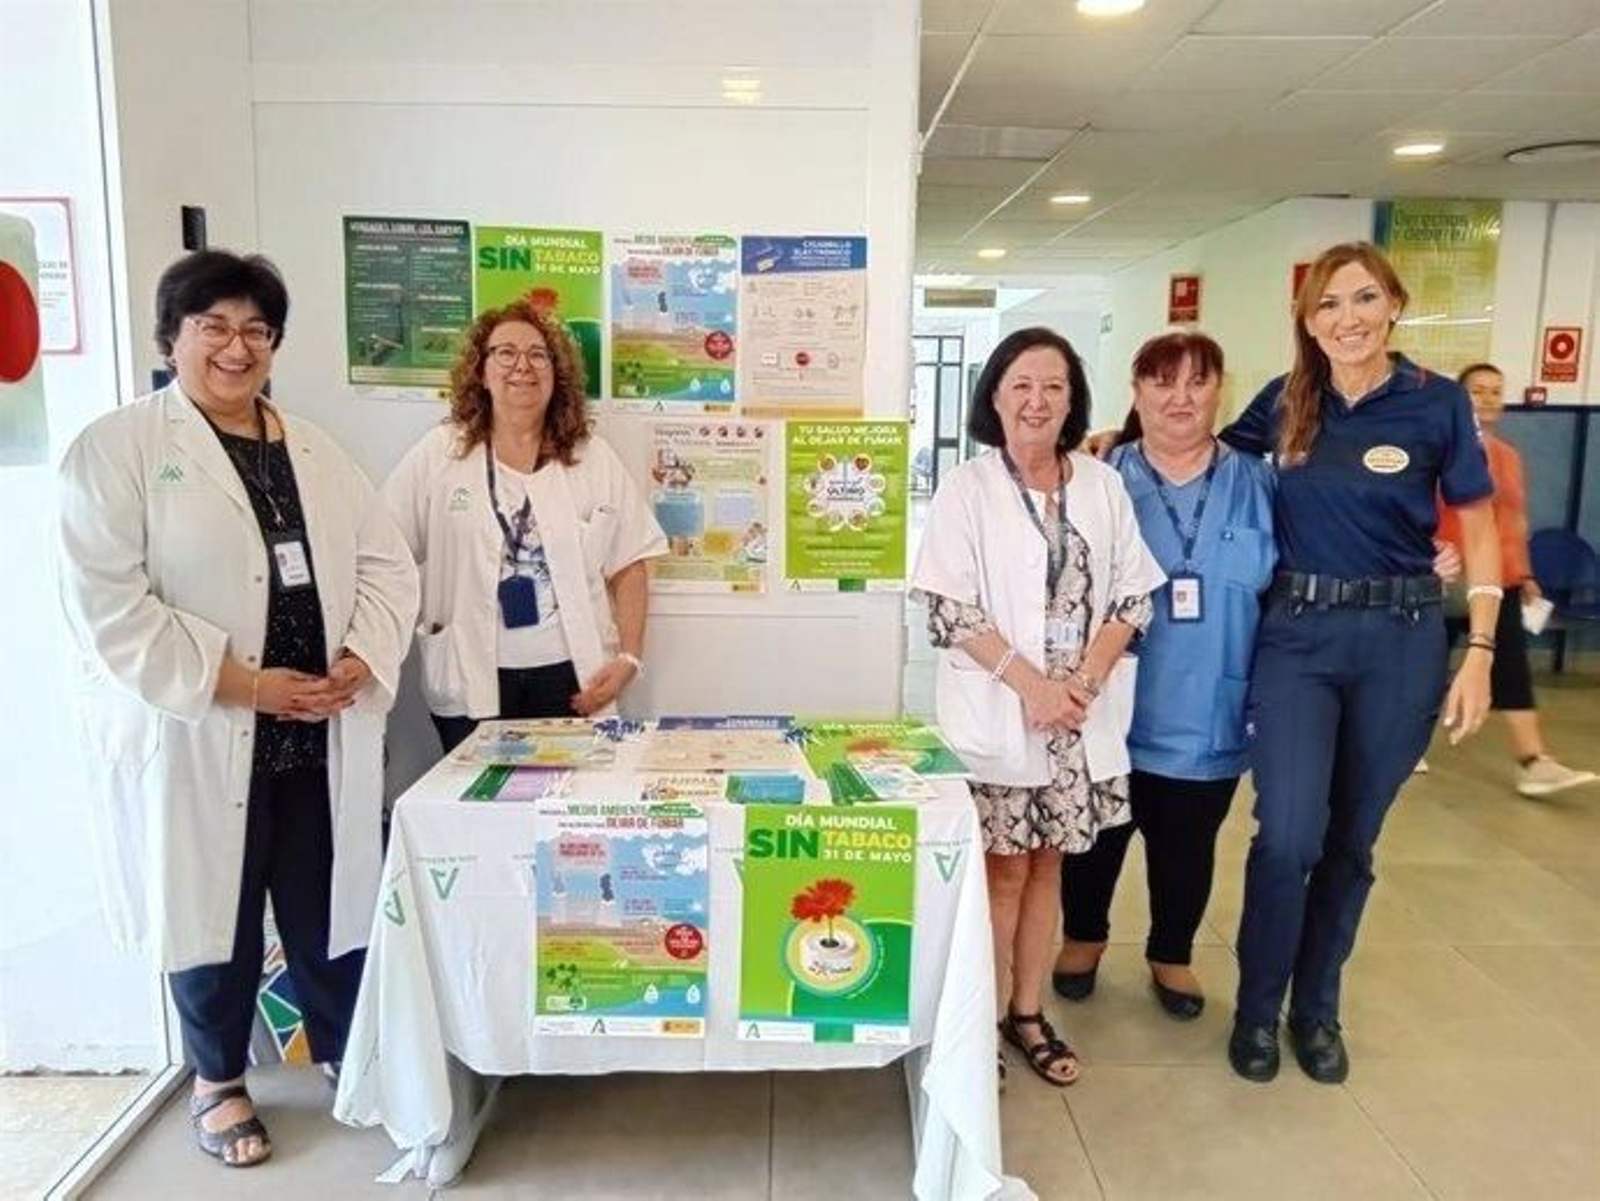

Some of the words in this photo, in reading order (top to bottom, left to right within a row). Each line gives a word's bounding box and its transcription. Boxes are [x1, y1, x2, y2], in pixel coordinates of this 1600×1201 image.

[530, 236, 587, 249] MUNDIAL
[479, 247, 531, 271] SIN
[534, 249, 599, 263] TABACO
[569, 265, 601, 275] MAYO
[799, 425, 815, 434] TU
[817, 425, 851, 434] SALUD
[785, 813, 815, 827] DÍA
[819, 816, 898, 830] MUNDIAL
[747, 829, 819, 858] SIN
[823, 831, 912, 849] TABACO
[822, 850, 838, 860] 31
[845, 851, 866, 861] DE
[870, 852, 912, 862] MAYO
